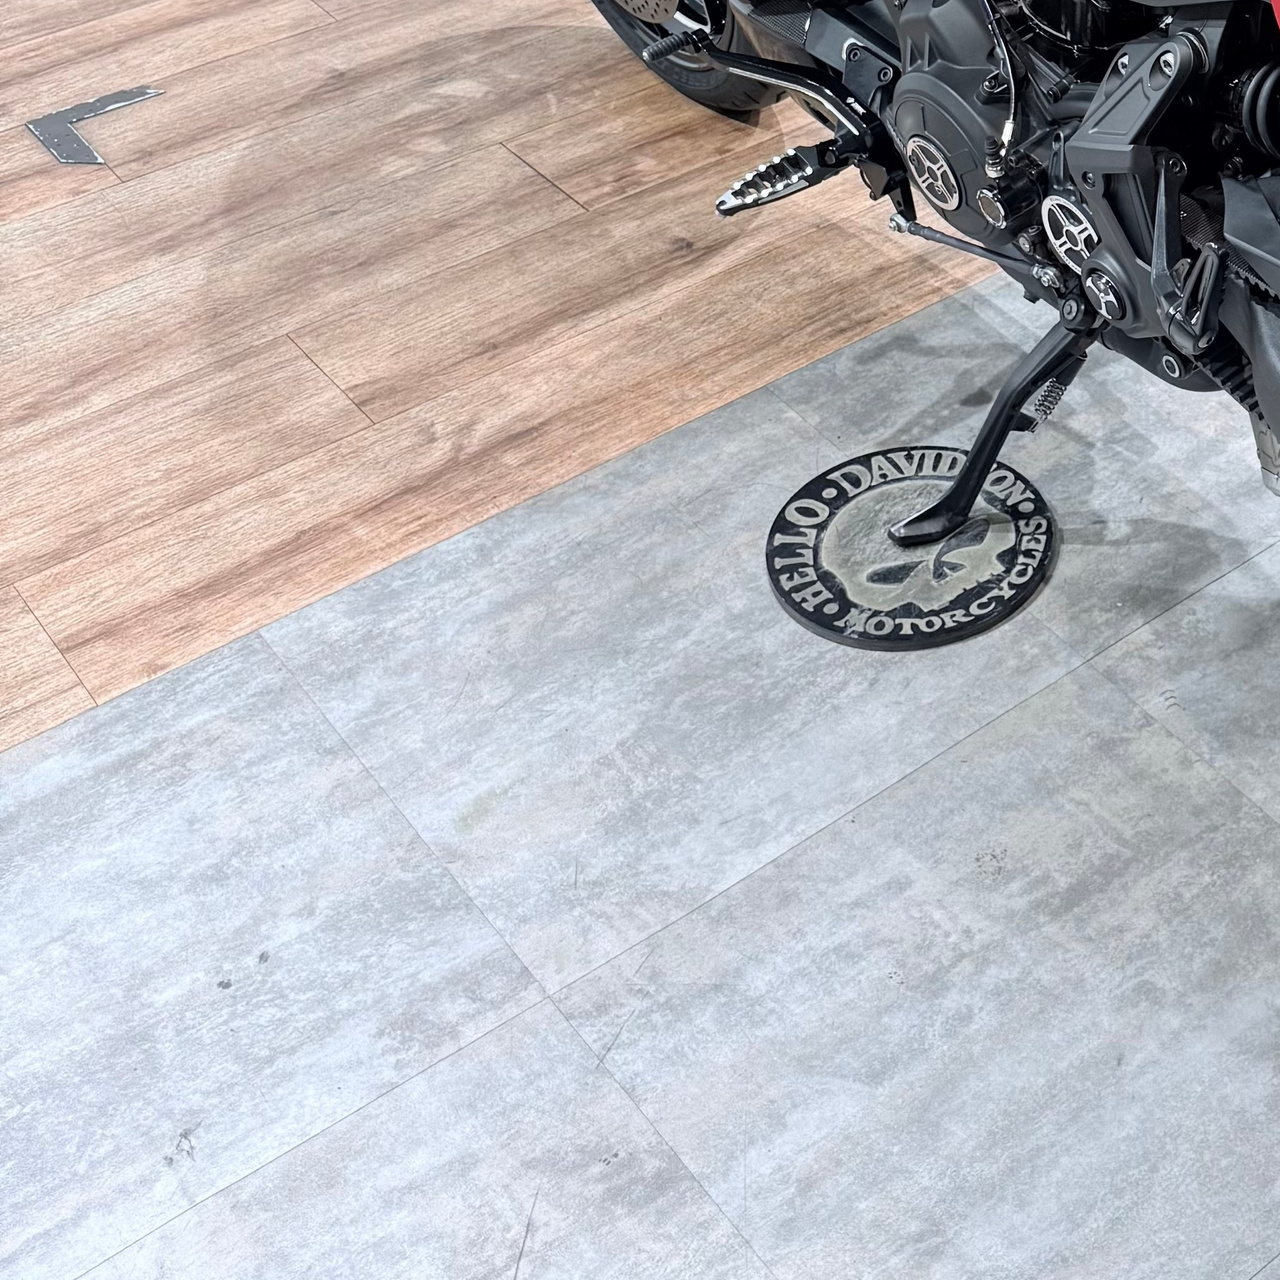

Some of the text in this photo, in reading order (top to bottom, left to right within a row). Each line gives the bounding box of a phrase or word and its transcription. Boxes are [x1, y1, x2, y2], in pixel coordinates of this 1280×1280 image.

[773, 449, 1036, 612] HELLO DAVIDON
[833, 515, 1048, 636] MOTORCYCLES
